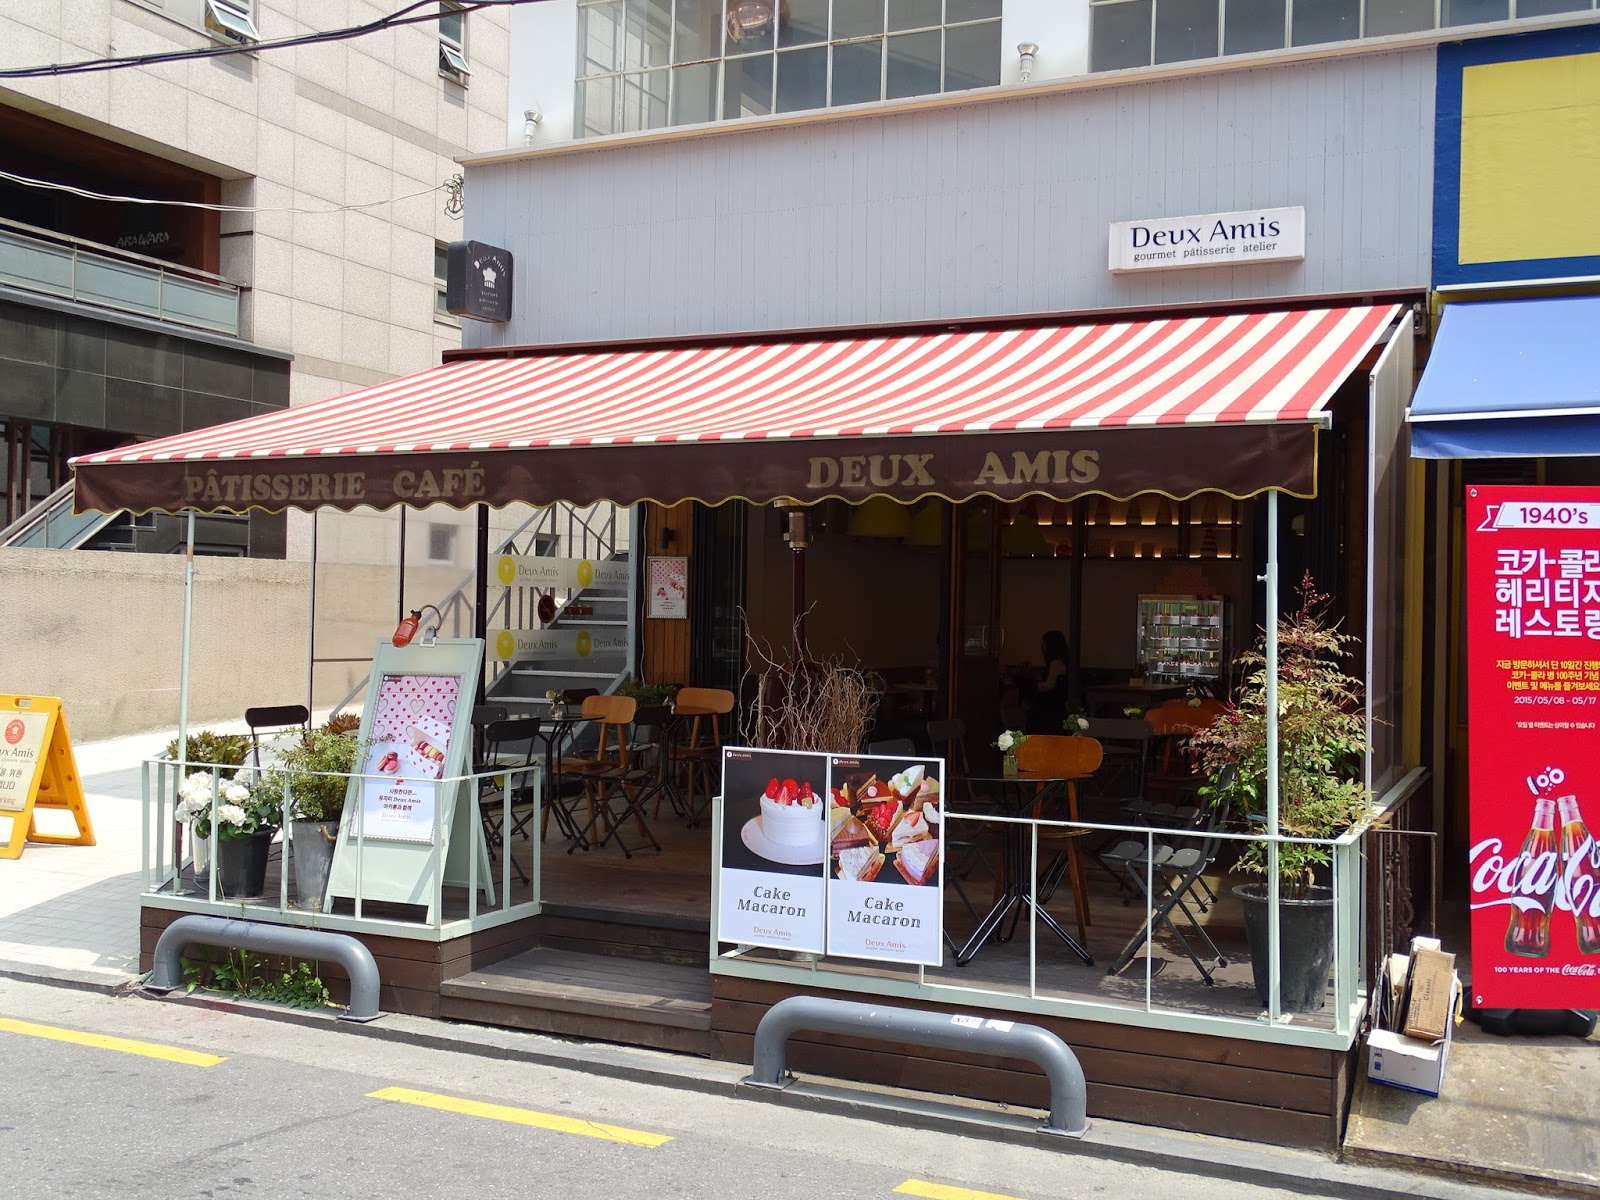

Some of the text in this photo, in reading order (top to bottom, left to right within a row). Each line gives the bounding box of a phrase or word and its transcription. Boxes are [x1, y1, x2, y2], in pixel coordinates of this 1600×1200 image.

[1131, 216, 1280, 248] Deux Amis
[1133, 241, 1278, 263] gourmet pâtisserie atelier
[806, 450, 1101, 488] DEUX AMIS
[185, 460, 486, 501] PÂTISSERIE CAFÉ
[1520, 507, 1588, 524] 1940's
[518, 564, 559, 577] Deux Amis
[595, 569, 630, 581] Deux Amis
[517, 639, 558, 650] Deux Amis
[594, 638, 611, 648] Deux
[1496, 660, 1511, 669] 지금
[1551, 660, 1559, 669] 단
[1561, 660, 1582, 670] 10일간
[1511, 671, 1545, 680] 코카-콜라
[1556, 671, 1582, 680] 100주년
[1584, 671, 1599, 680] 기념
[1506, 681, 1529, 690] 이벤트
[1530, 681, 1538, 690] 및
[1514, 696, 1565, 705] 2015/05/08
[1571, 696, 1597, 705] 05/17
[11, 748, 34, 758] Amis
[753, 886, 791, 901] Cake
[737, 898, 806, 918] Macaron
[864, 896, 904, 911] Cake
[847, 910, 921, 928] Macaron
[753, 926, 773, 935] Deux
[773, 928, 792, 938] Amis
[865, 938, 906, 949] Deux Amis
